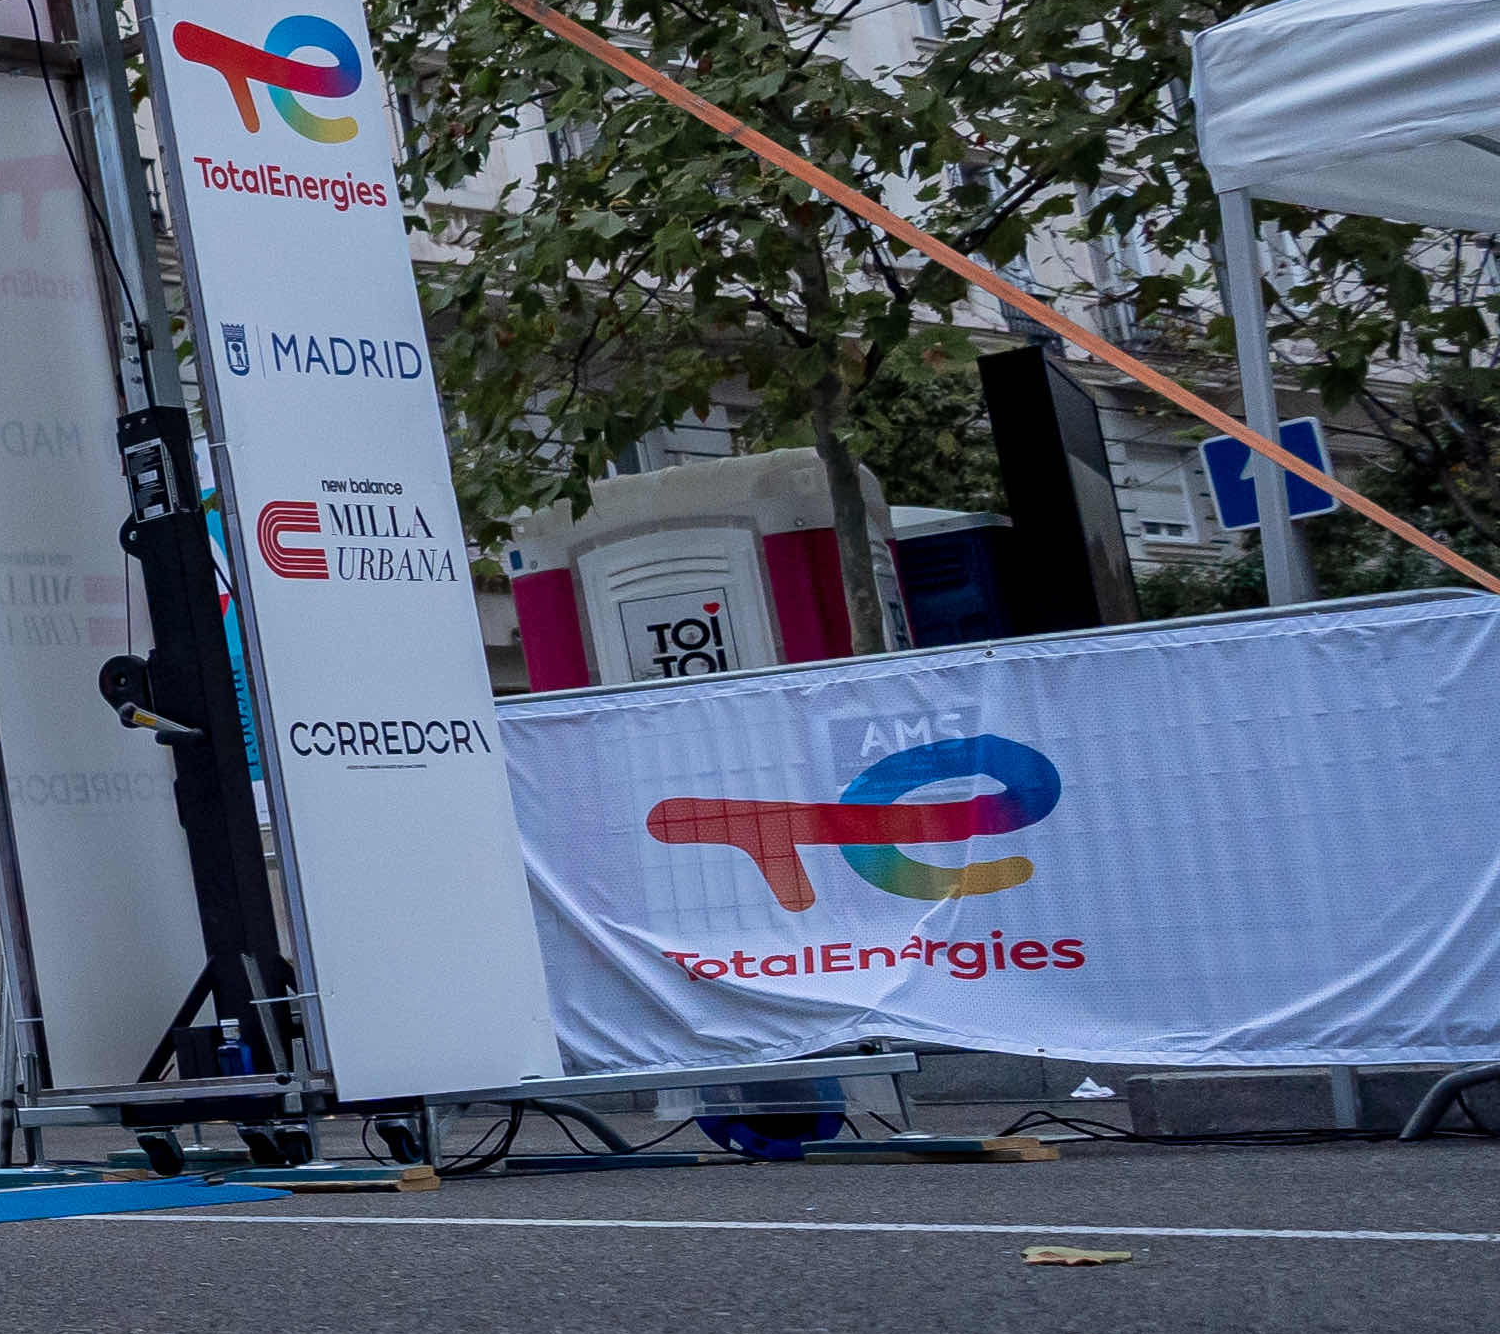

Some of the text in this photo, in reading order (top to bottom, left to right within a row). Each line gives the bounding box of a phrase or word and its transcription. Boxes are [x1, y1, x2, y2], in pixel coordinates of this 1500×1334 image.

[193, 156, 388, 212] TotalEnergies
[271, 332, 424, 381] MADRID
[321, 477, 403, 497] new balance
[328, 502, 436, 541] MILLA
[336, 547, 459, 584] URBANA
[646, 614, 723, 653] TOI
[653, 648, 727, 678] TOI
